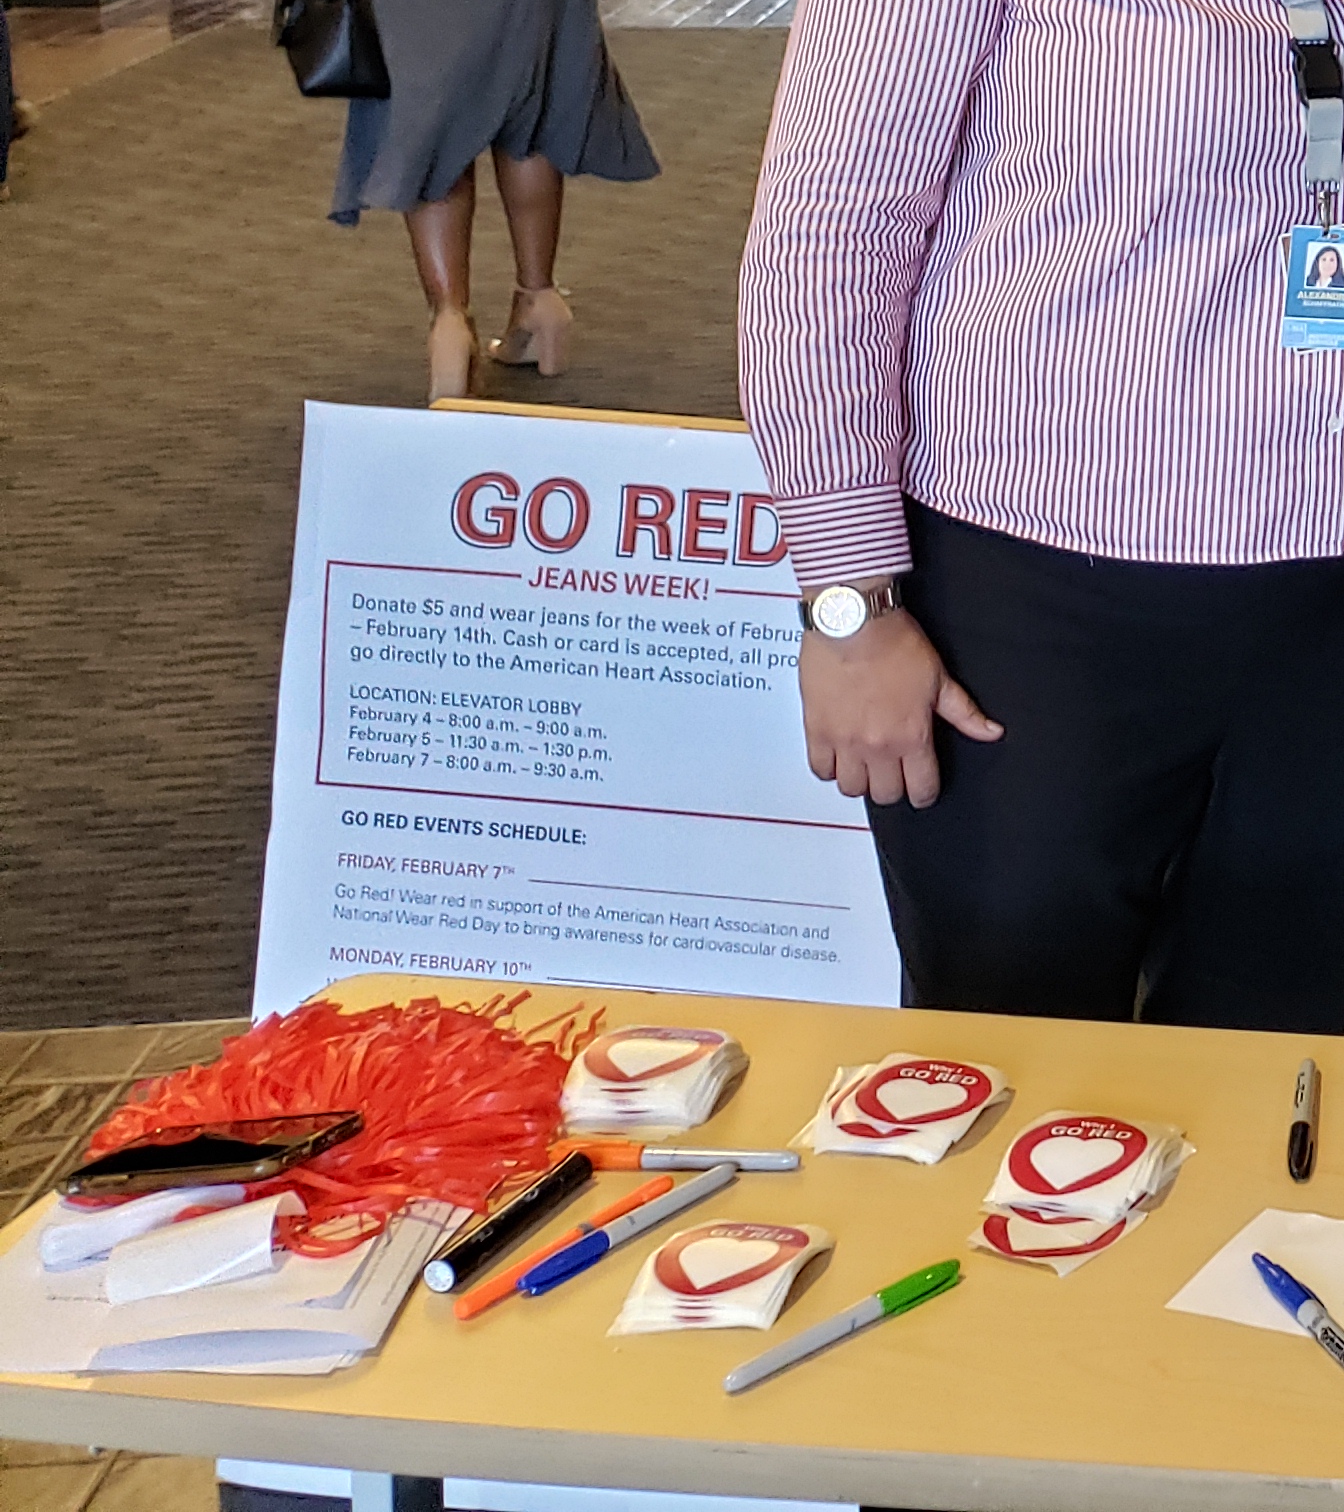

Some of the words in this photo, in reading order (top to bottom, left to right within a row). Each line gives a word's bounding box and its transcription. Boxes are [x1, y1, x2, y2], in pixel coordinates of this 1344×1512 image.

[450, 471, 590, 554] GO
[616, 482, 788, 568] RED
[528, 565, 617, 593] JEANS
[625, 571, 710, 600] WEEK!
[353, 593, 416, 615] Donate
[422, 598, 444, 616] $5
[450, 603, 484, 619] and
[490, 608, 536, 622] wear
[540, 607, 590, 628] jeans
[596, 611, 621, 628] for
[628, 615, 656, 631] the
[662, 618, 710, 636] week
[716, 621, 735, 637] of
[366, 618, 446, 645] February
[454, 627, 497, 645] 14th.
[503, 629, 547, 650] Cash
[555, 638, 573, 651] or
[580, 638, 619, 654] card
[626, 638, 639, 655] is
[646, 643, 734, 664] accepted,
[740, 648, 761, 665] all
[350, 645, 373, 662] go
[380, 645, 446, 669] directly
[453, 652, 470, 667] to
[477, 652, 505, 669] the
[510, 655, 599, 677] American
[605, 661, 654, 682] Heart
[660, 666, 772, 691] Association.
[350, 684, 437, 705] LOCATION:
[442, 692, 523, 712] ELEVATOR
[528, 699, 582, 717] LOBBY
[350, 706, 418, 726] February
[422, 712, 431, 725] 4
[449, 714, 481, 730] 8:00
[486, 718, 519, 733] a.m.
[537, 721, 569, 737] 9:00
[574, 725, 607, 739] a.m.
[349, 726, 417, 748] February
[421, 732, 431, 746] 5
[451, 734, 487, 750] 11:30
[491, 739, 524, 754] a.m.
[543, 742, 573, 757] 1:30
[578, 746, 612, 761] p.m.
[348, 746, 415, 768] February
[421, 753, 429, 767] 7
[446, 755, 479, 771] 8:00
[483, 760, 516, 774] a.m.
[534, 762, 566, 778] 9:30
[570, 767, 603, 782] a.m.
[341, 810, 368, 827] GO
[374, 812, 407, 830] RED
[414, 816, 483, 836] EVENTS
[489, 822, 587, 845] SCHEDULE:
[338, 852, 396, 873] FRIDAY,
[401, 857, 489, 879] FEBRUARY
[335, 883, 355, 900] Go
[361, 884, 394, 902] Red!
[400, 888, 437, 906] Wear
[441, 893, 465, 908] red
[471, 897, 483, 910] in
[487, 897, 543, 918] support
[547, 901, 562, 917] of
[567, 903, 590, 920] the
[594, 905, 664, 926] American
[670, 912, 709, 930] Heart
[714, 916, 797, 938] Association
[802, 925, 830, 940] and
[333, 905, 394, 924] National
[396, 909, 433, 928] Wear
[439, 913, 467, 931] Red
[472, 916, 500, 935] Day
[505, 920, 519, 934] to
[524, 920, 559, 941] bring
[564, 926, 643, 945] awareness
[650, 930, 668, 947] for
[673, 937, 775, 958] cardiovascular
[781, 944, 841, 963] disease.
[329, 946, 404, 969] MONDAY,
[410, 953, 497, 974] FEBRUARY
[899, 1065, 933, 1081] GO
[935, 1070, 978, 1086] RED
[1050, 1124, 1085, 1138] GO
[1089, 1128, 1131, 1141] RED
